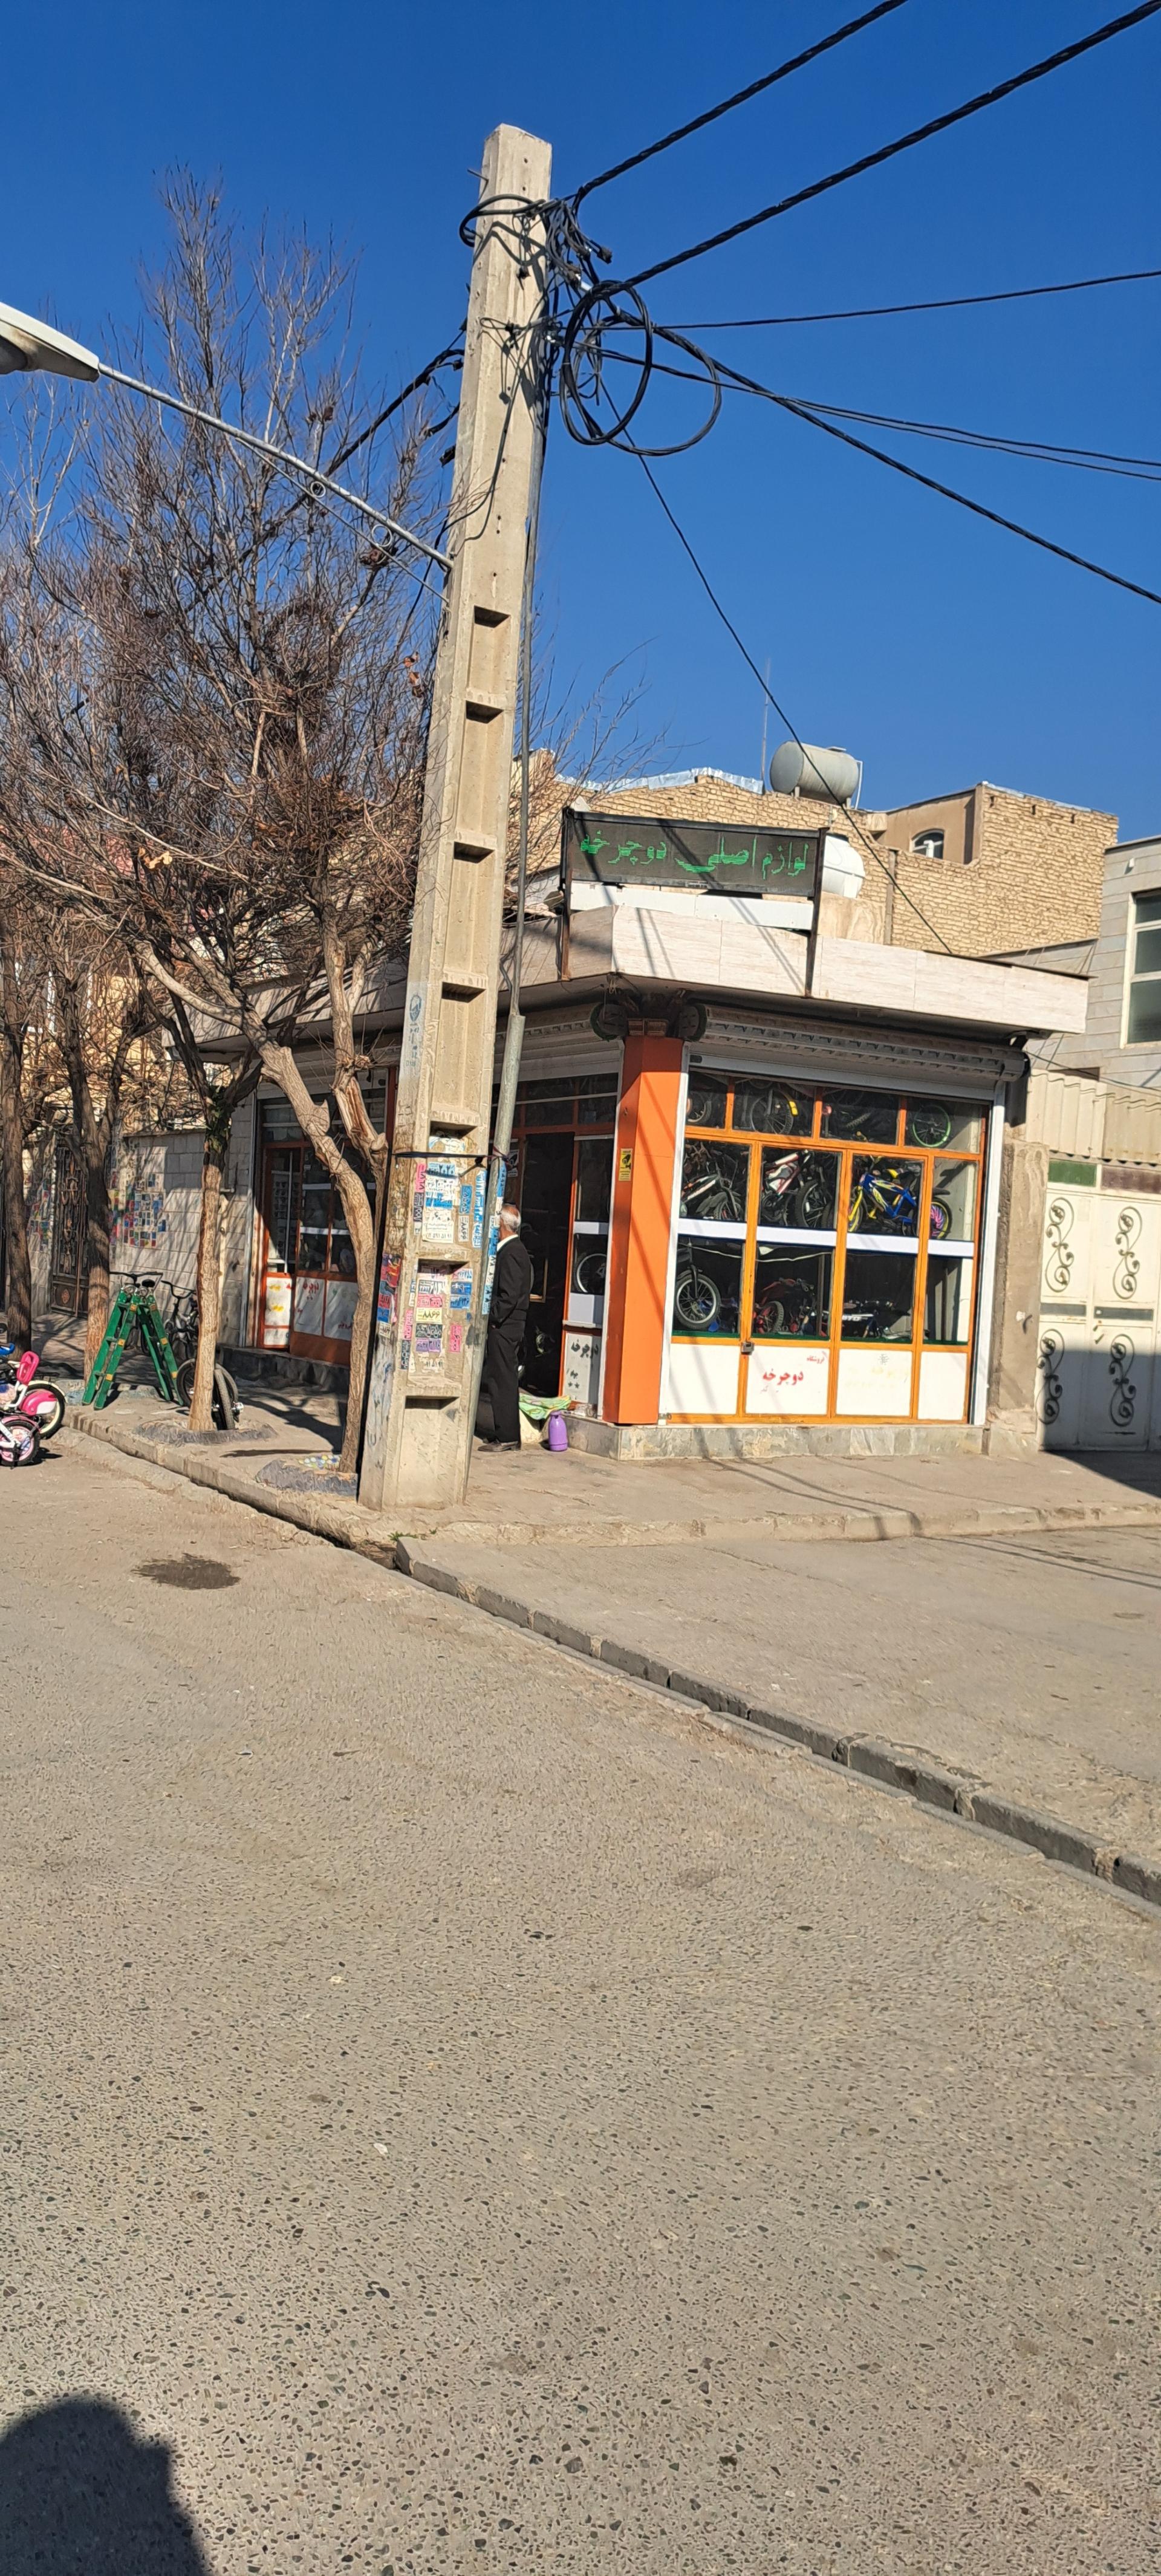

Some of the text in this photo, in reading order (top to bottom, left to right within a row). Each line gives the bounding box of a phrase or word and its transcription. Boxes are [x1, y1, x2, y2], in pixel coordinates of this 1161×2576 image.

[580, 830, 808, 880] لوازم اصلی دوچرخه
